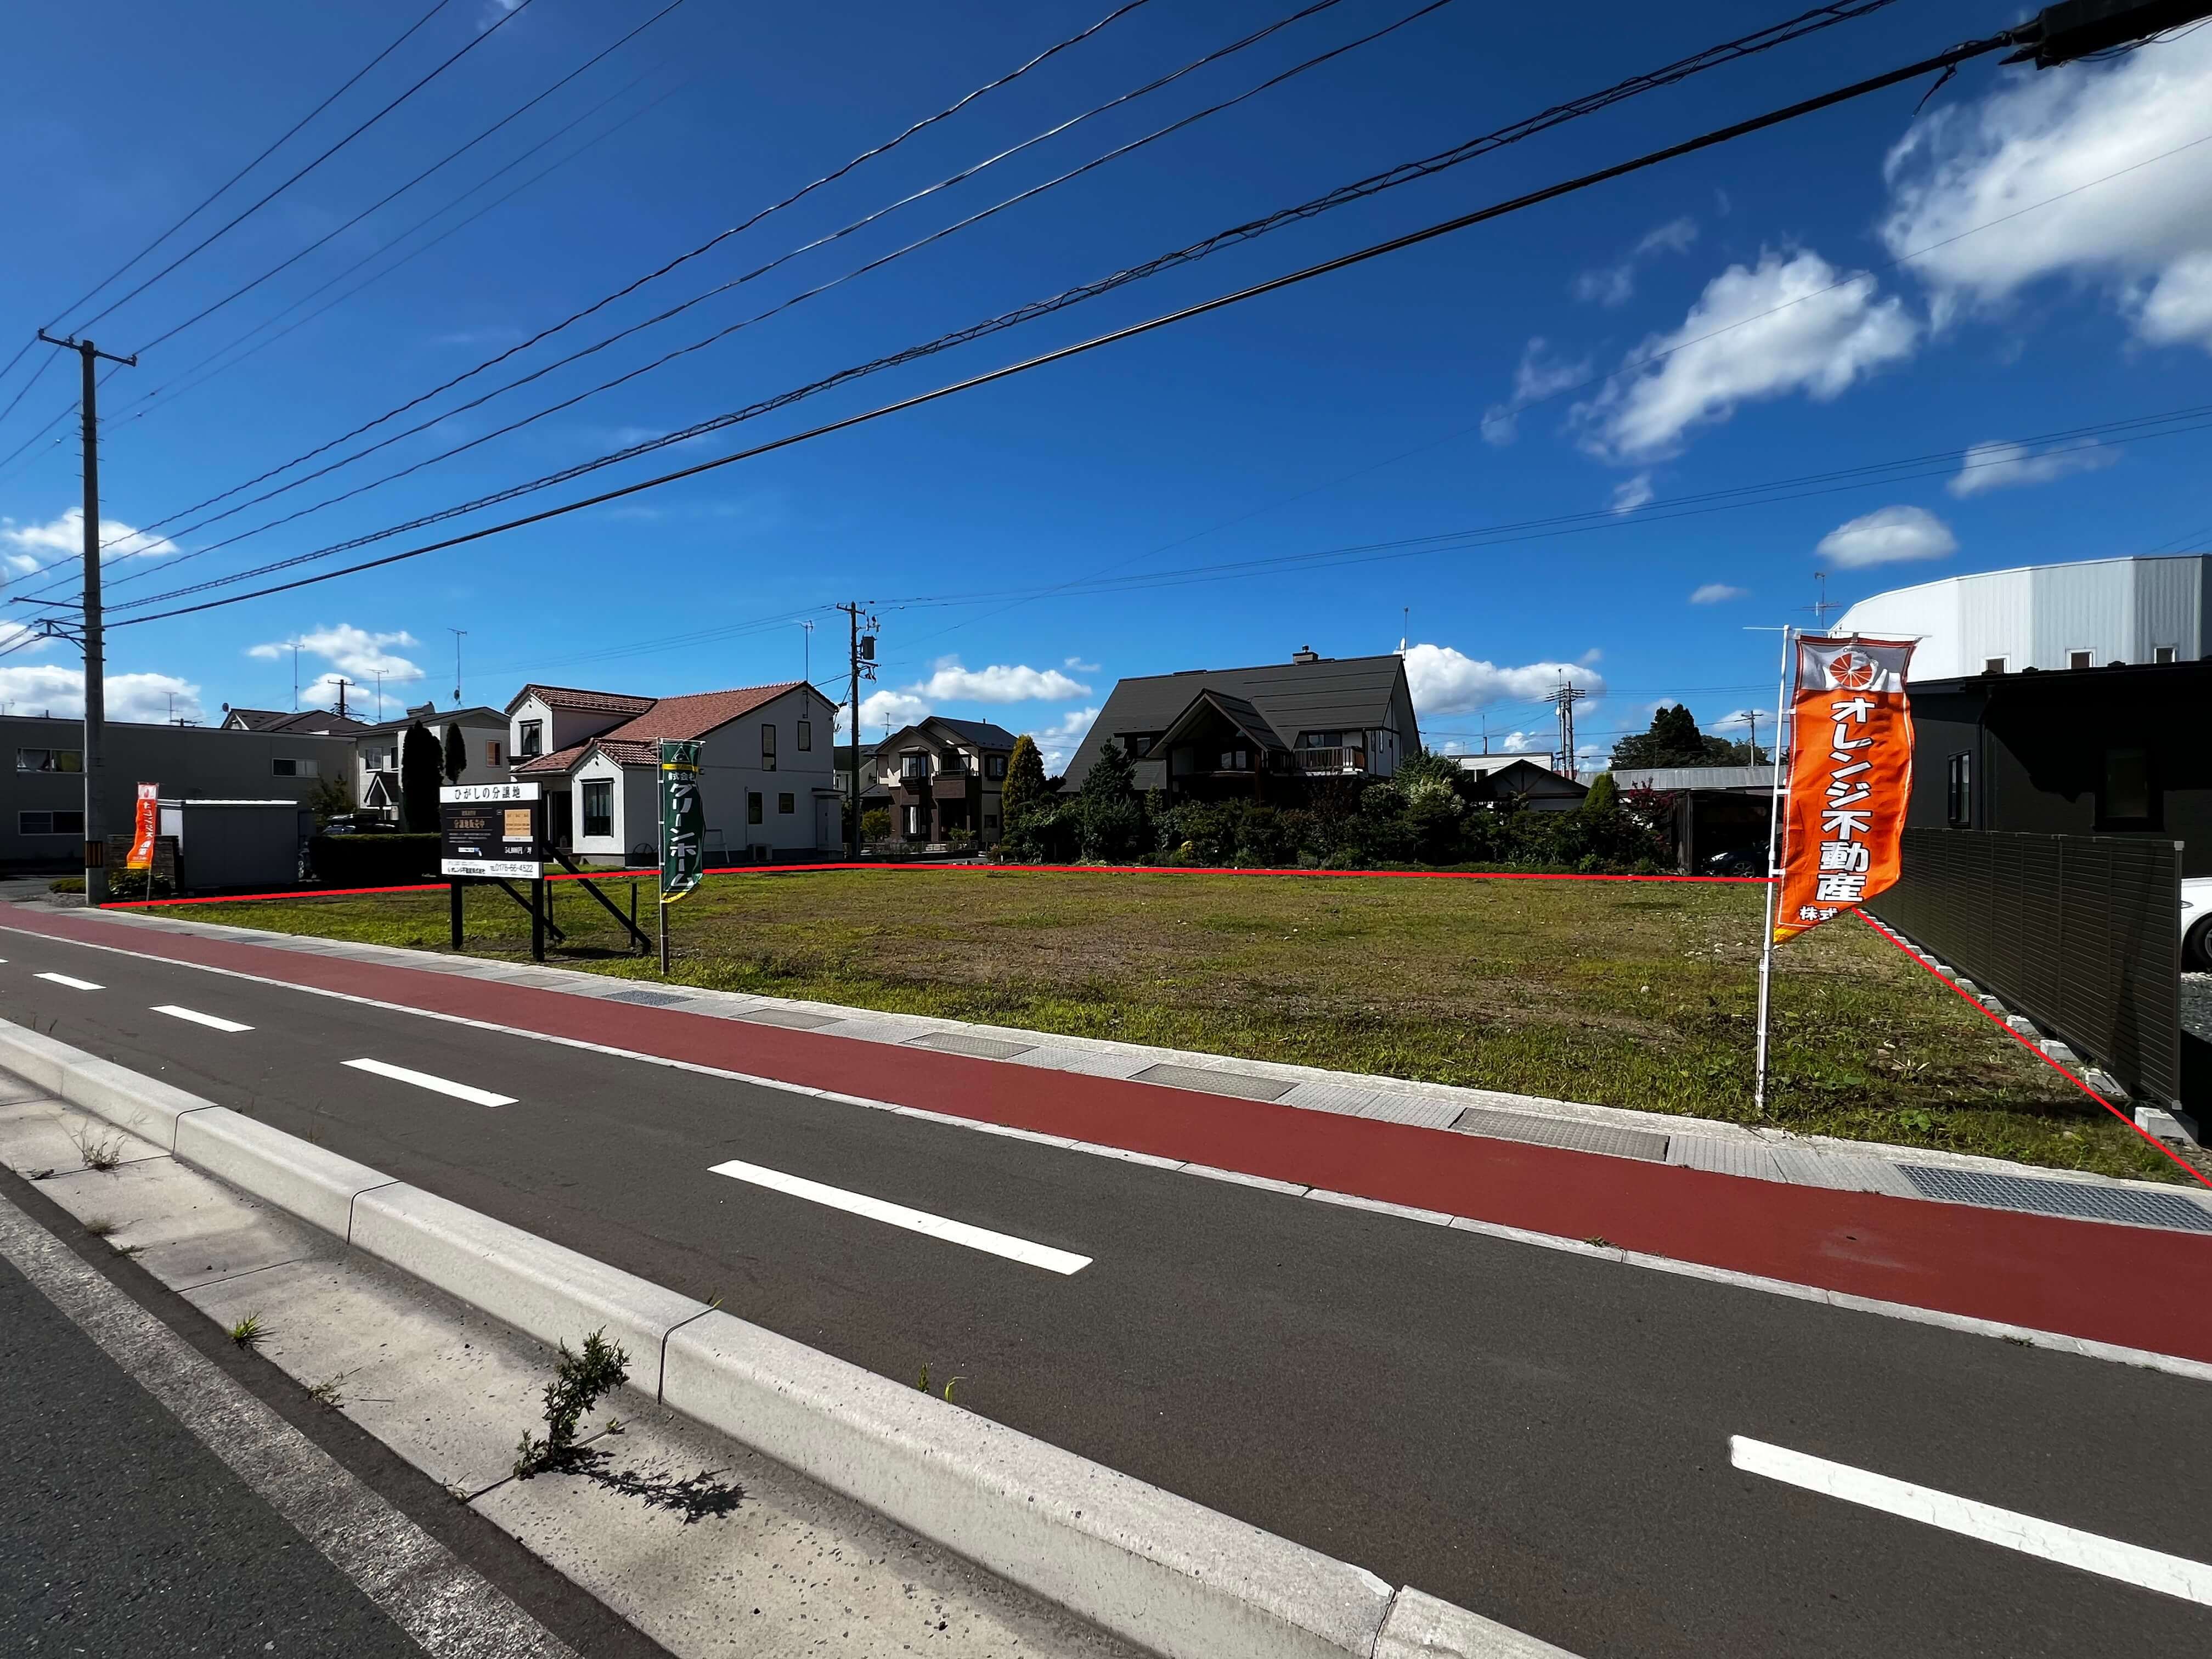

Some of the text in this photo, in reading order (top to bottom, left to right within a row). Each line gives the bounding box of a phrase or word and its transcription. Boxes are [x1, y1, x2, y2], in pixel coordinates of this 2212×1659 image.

[454, 786, 521, 799] ひがしの分譲地
[1815, 697, 1875, 902] オレンジ不動産
[669, 783, 696, 887] グリーンホーム
[1799, 905, 1838, 921] 株式
